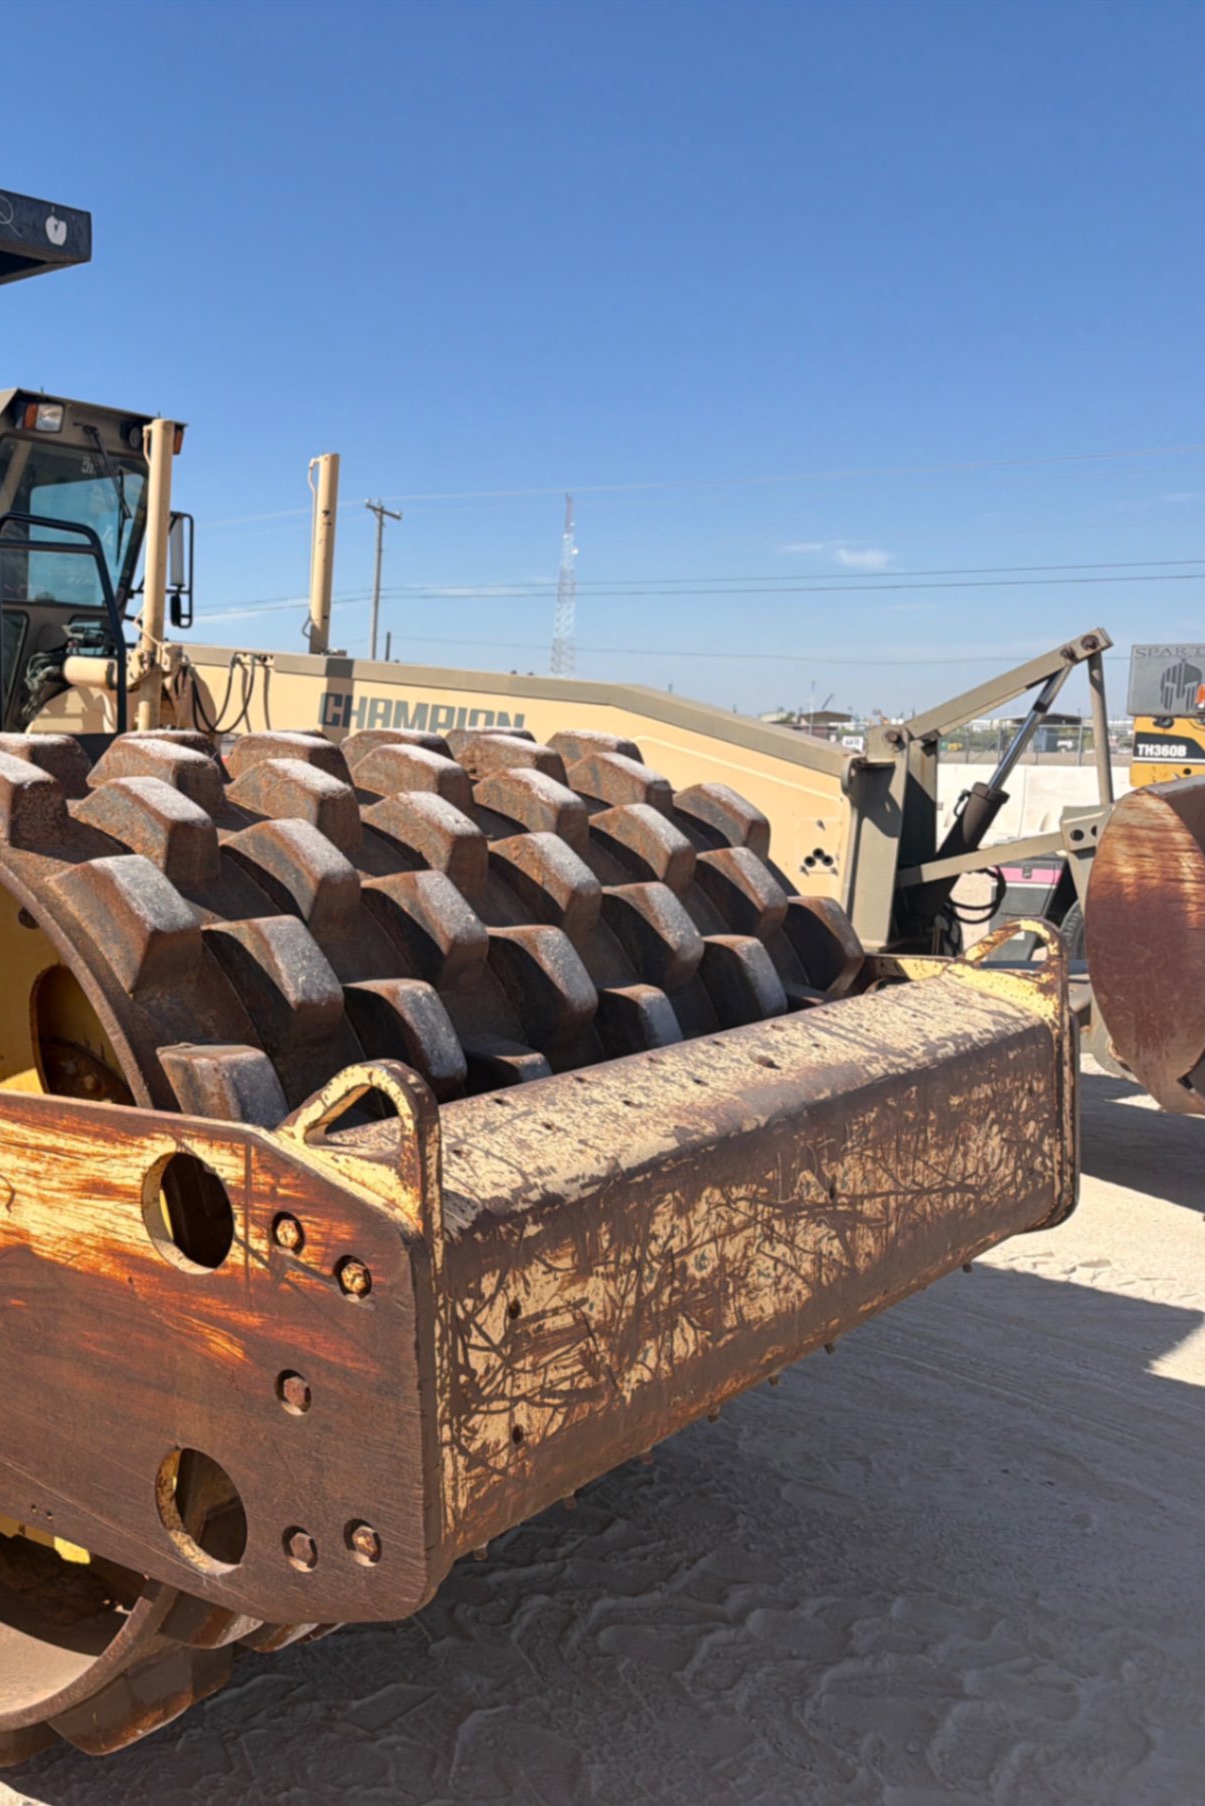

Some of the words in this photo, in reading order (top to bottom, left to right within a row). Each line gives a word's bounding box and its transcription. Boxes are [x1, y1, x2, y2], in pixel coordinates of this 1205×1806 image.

[1135, 647, 1205, 658] SPART
[319, 693, 525, 730] CHAMPION
[1137, 744, 1187, 757] TH360B
